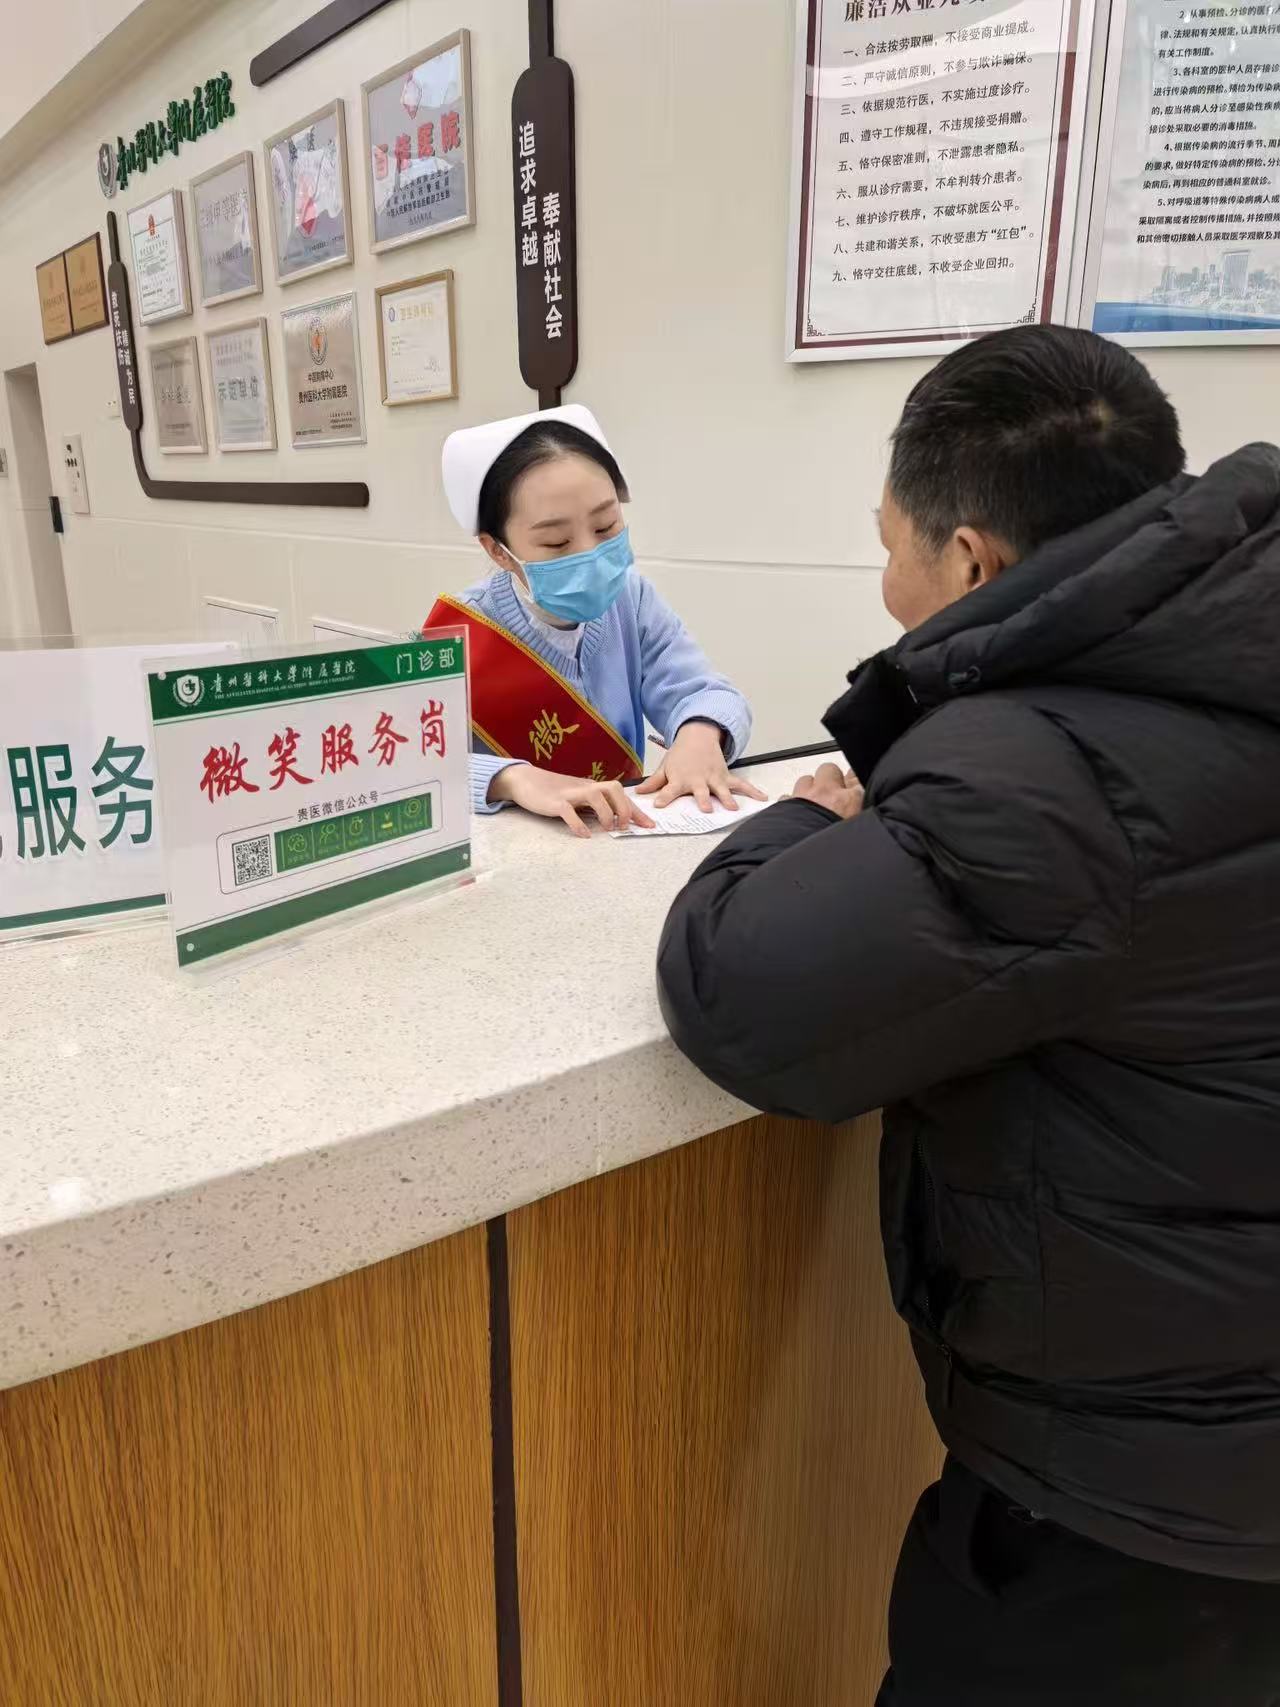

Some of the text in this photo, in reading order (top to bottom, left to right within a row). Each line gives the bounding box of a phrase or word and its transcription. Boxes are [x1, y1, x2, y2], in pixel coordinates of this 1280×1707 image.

[519, 121, 538, 267] 追求卓越
[543, 192, 562, 339] 奉献社会
[396, 647, 454, 675] 门诊部
[0, 736, 153, 860] 服务
[200, 699, 447, 803] 微笑服务岗
[297, 791, 379, 823] 贵医微信公众号
